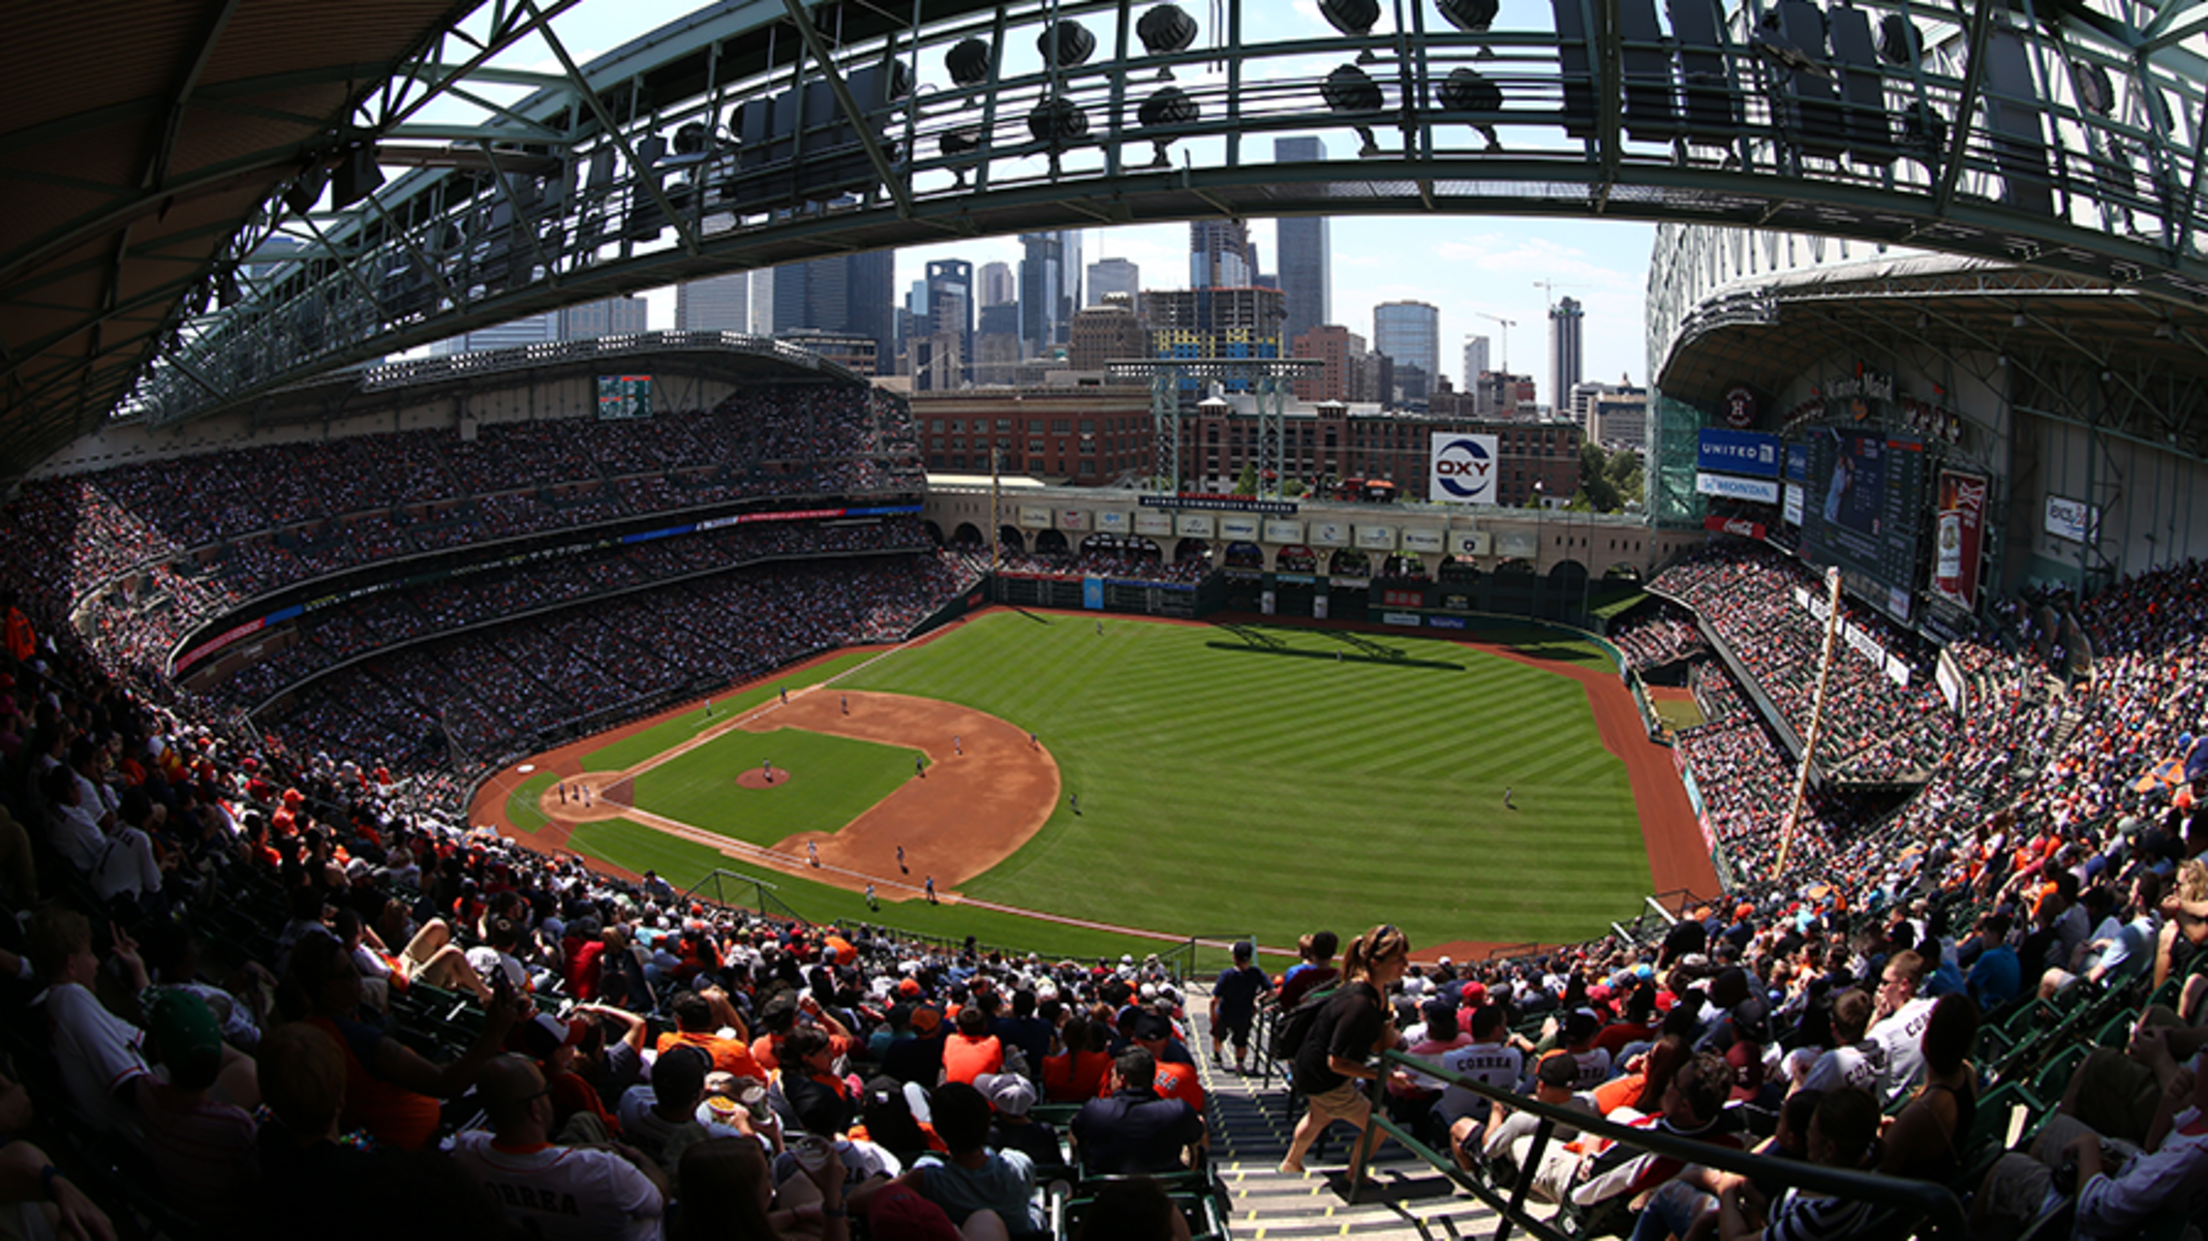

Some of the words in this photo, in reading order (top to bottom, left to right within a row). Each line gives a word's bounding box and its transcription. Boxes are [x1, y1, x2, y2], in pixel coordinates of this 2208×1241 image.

[1702, 443, 1757, 459] UNITED
[1437, 460, 1490, 477] OXY
[1717, 480, 1770, 497] HONDA
[1457, 1056, 1512, 1072] CORREA
